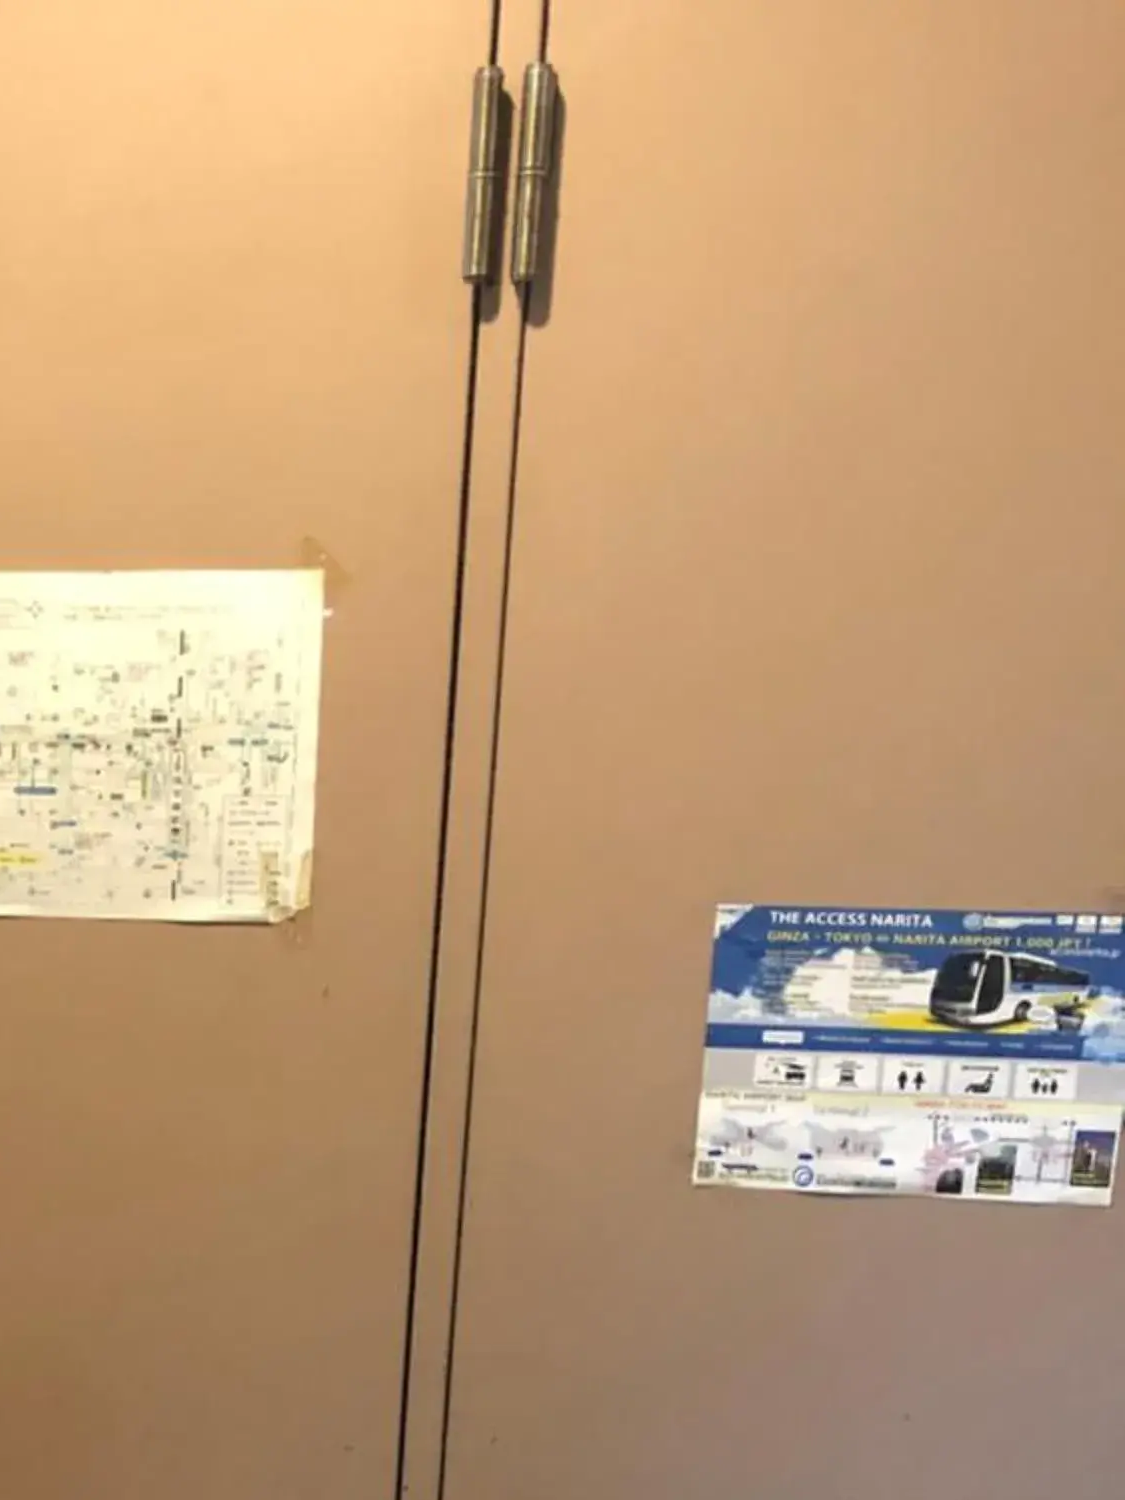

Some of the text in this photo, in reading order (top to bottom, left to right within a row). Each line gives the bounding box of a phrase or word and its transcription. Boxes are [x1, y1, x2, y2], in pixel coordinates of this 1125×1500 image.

[770, 910, 933, 928] THE ACCESS NARITA
[767, 930, 810, 942] GINZA
[825, 932, 872, 944] TOKYO
[893, 933, 945, 945] NARITA
[950, 935, 1010, 947] AIRPORT
